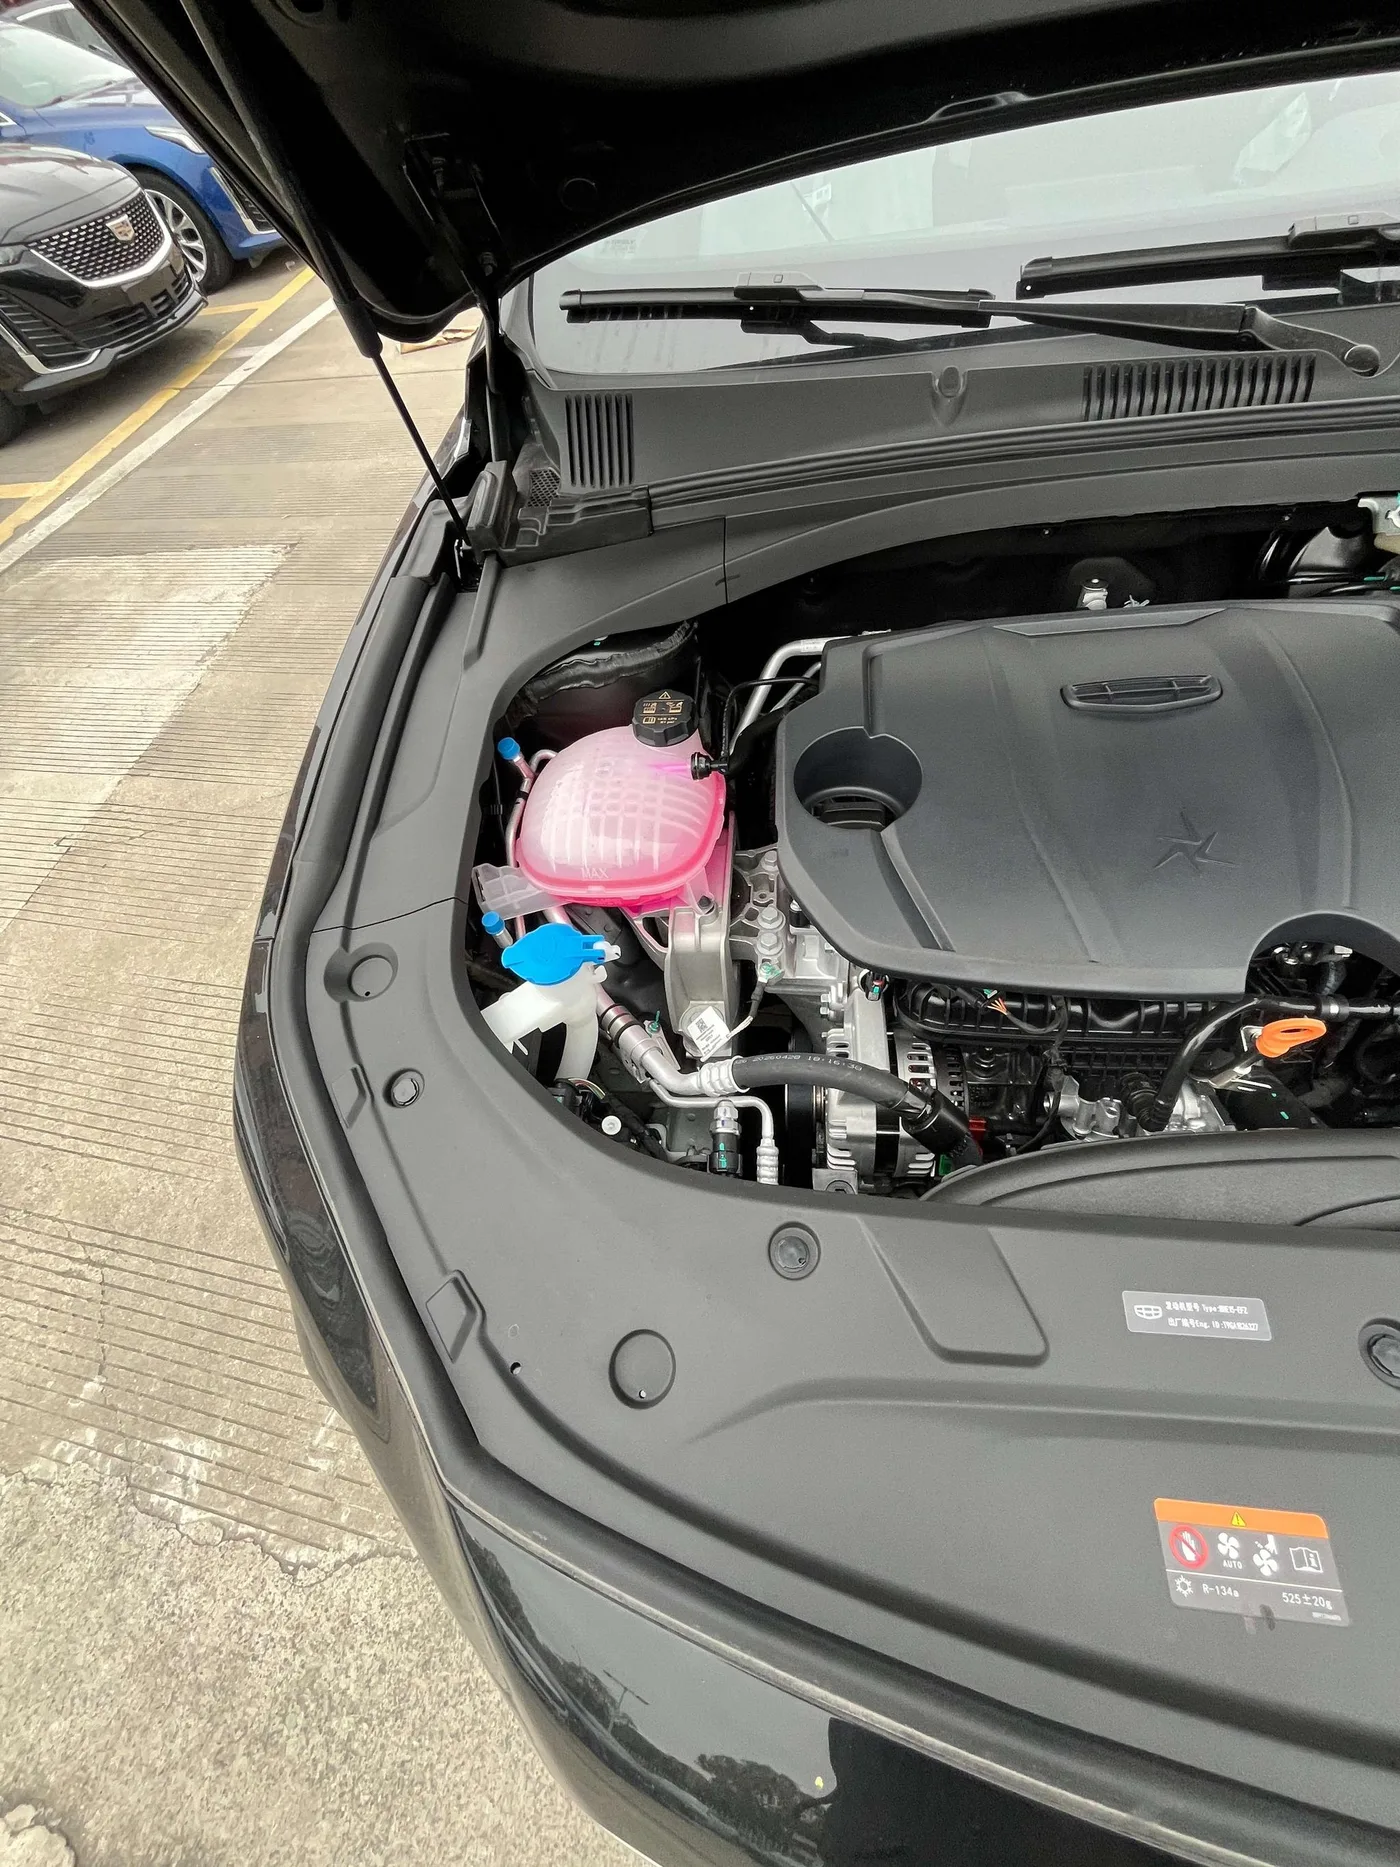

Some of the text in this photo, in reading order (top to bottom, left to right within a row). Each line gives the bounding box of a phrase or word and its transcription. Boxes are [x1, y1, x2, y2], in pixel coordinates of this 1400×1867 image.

[581, 867, 608, 879] MAX
[1222, 1559, 1243, 1570] AUTO
[1202, 1583, 1240, 1598] R-134a
